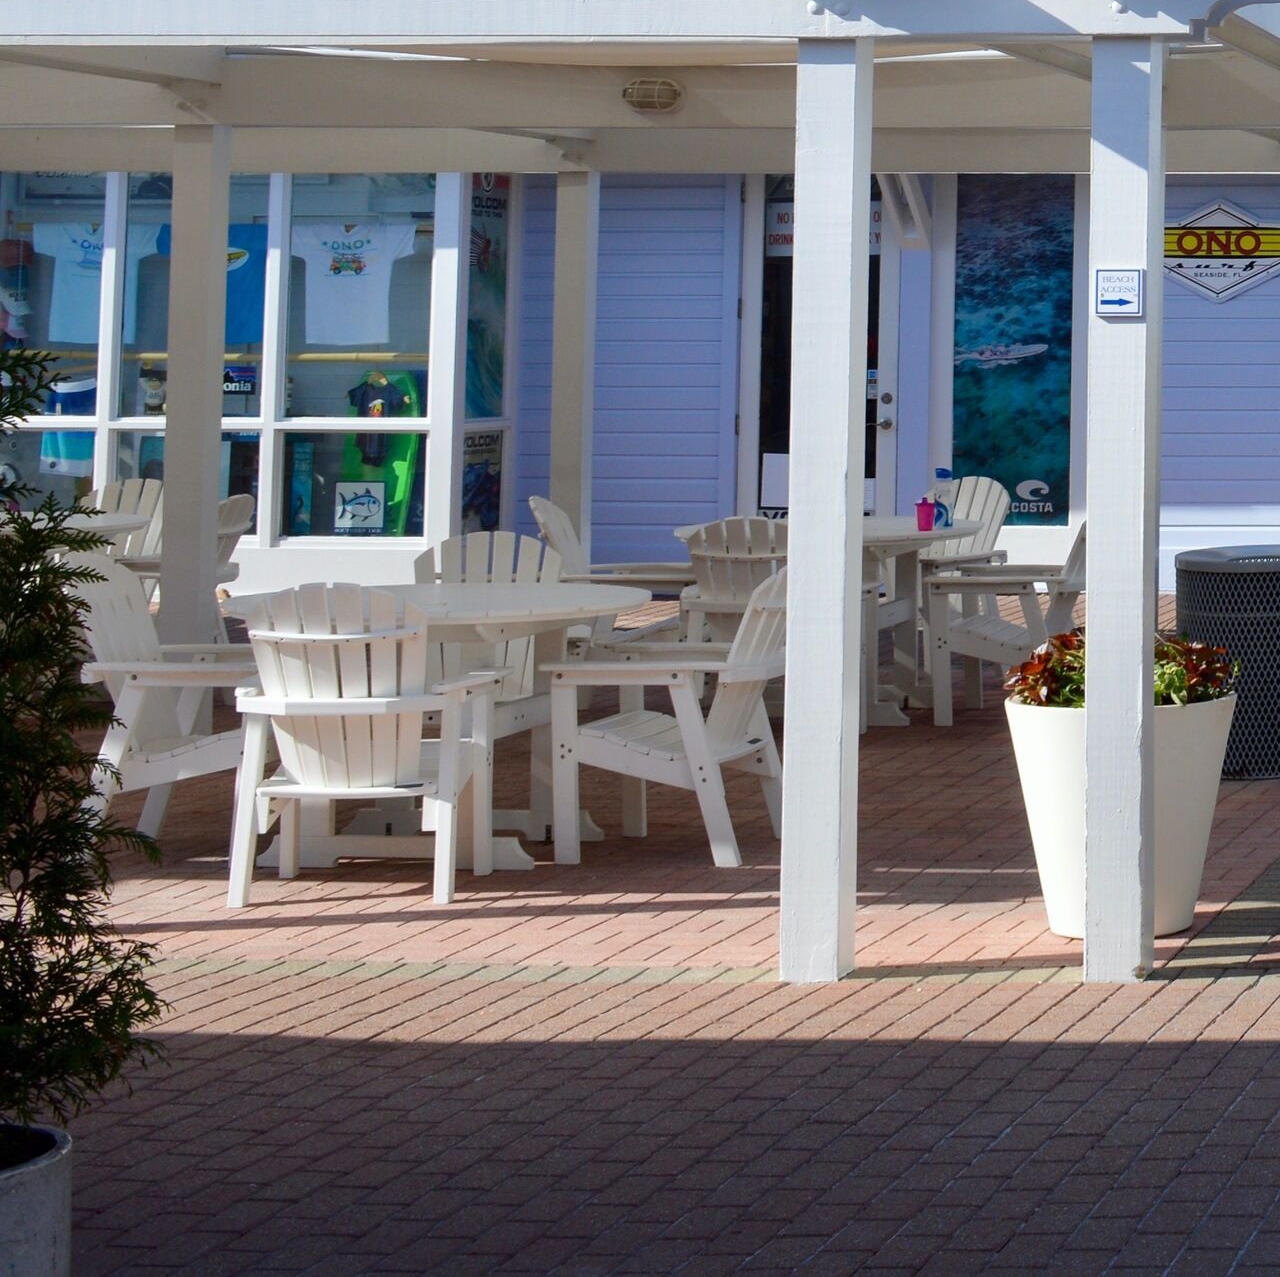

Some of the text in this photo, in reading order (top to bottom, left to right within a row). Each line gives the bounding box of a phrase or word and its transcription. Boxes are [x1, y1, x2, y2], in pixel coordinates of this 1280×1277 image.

[777, 212, 790, 224] NO
[331, 239, 364, 250] ONO
[1177, 231, 1261, 256] ONO
[1102, 275, 1134, 283] BEACH
[1011, 502, 1053, 512] COSTA
